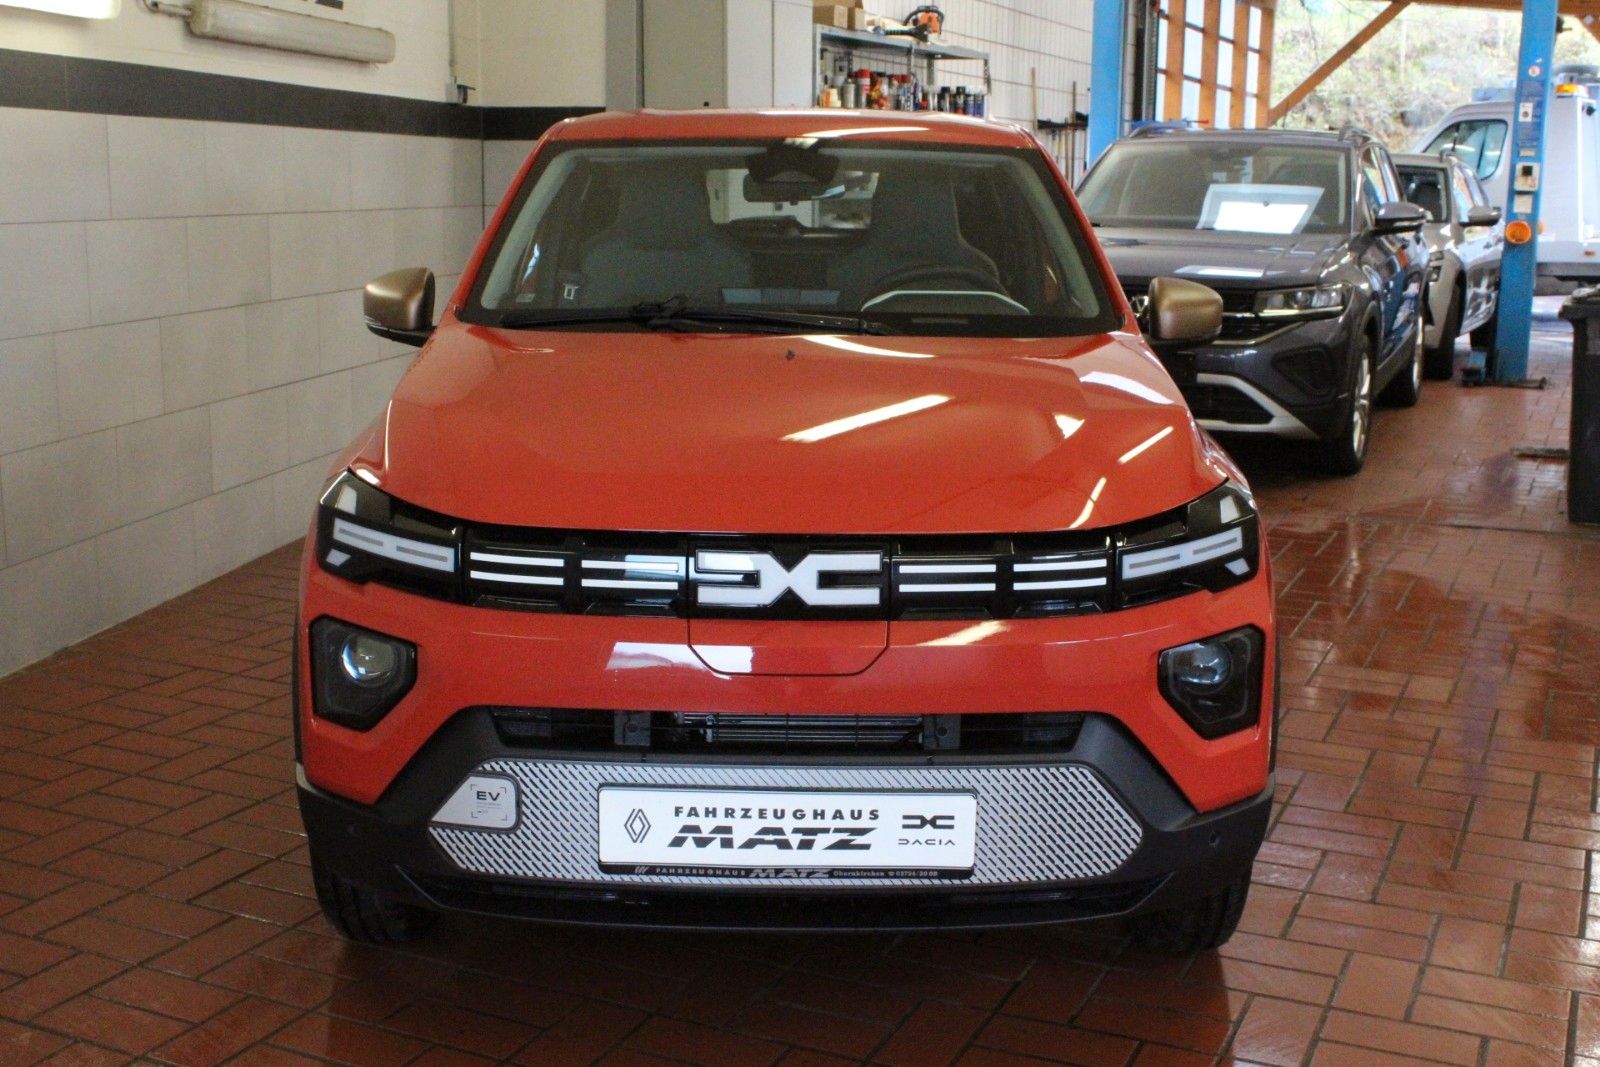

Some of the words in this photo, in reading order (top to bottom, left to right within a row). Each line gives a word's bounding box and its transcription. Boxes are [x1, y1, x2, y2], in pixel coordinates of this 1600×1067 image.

[476, 790, 501, 801] EV
[674, 805, 880, 821] FAHRZEUGHAUS
[667, 824, 878, 851] MATZ
[897, 838, 956, 846] DACIA
[655, 867, 746, 876] FAHRZEUGHAUS
[749, 867, 831, 879] MATZ
